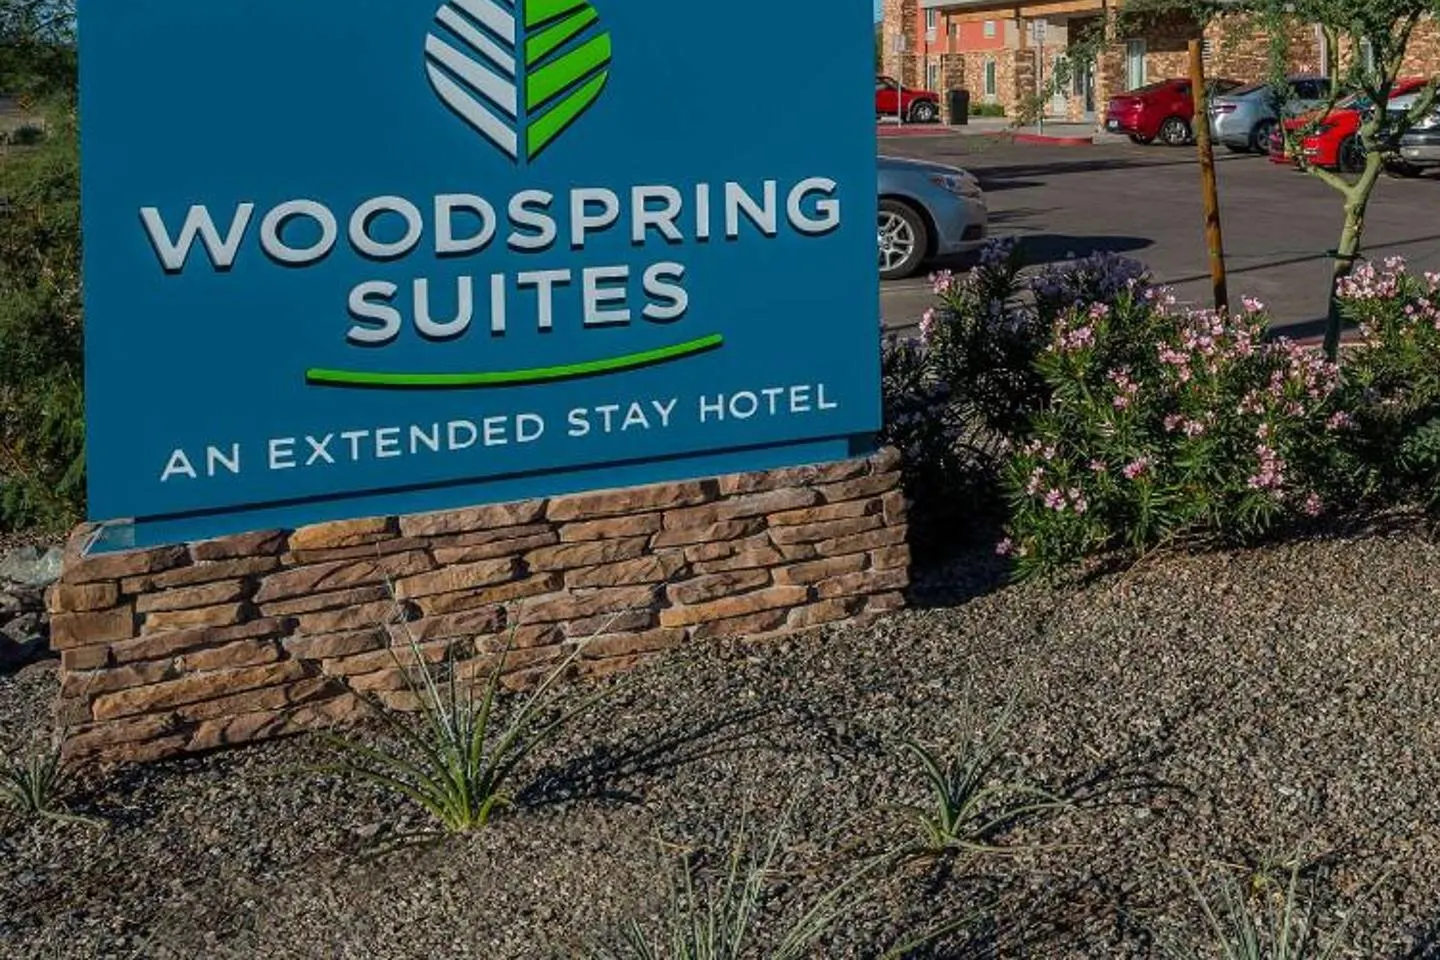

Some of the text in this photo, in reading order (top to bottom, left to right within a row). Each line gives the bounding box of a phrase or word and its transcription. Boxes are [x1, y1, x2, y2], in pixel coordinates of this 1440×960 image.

[140, 176, 842, 272] WOODSPRING
[347, 261, 690, 343] SUITES
[160, 383, 838, 481] AN EXTENDED STAY HOTEL
